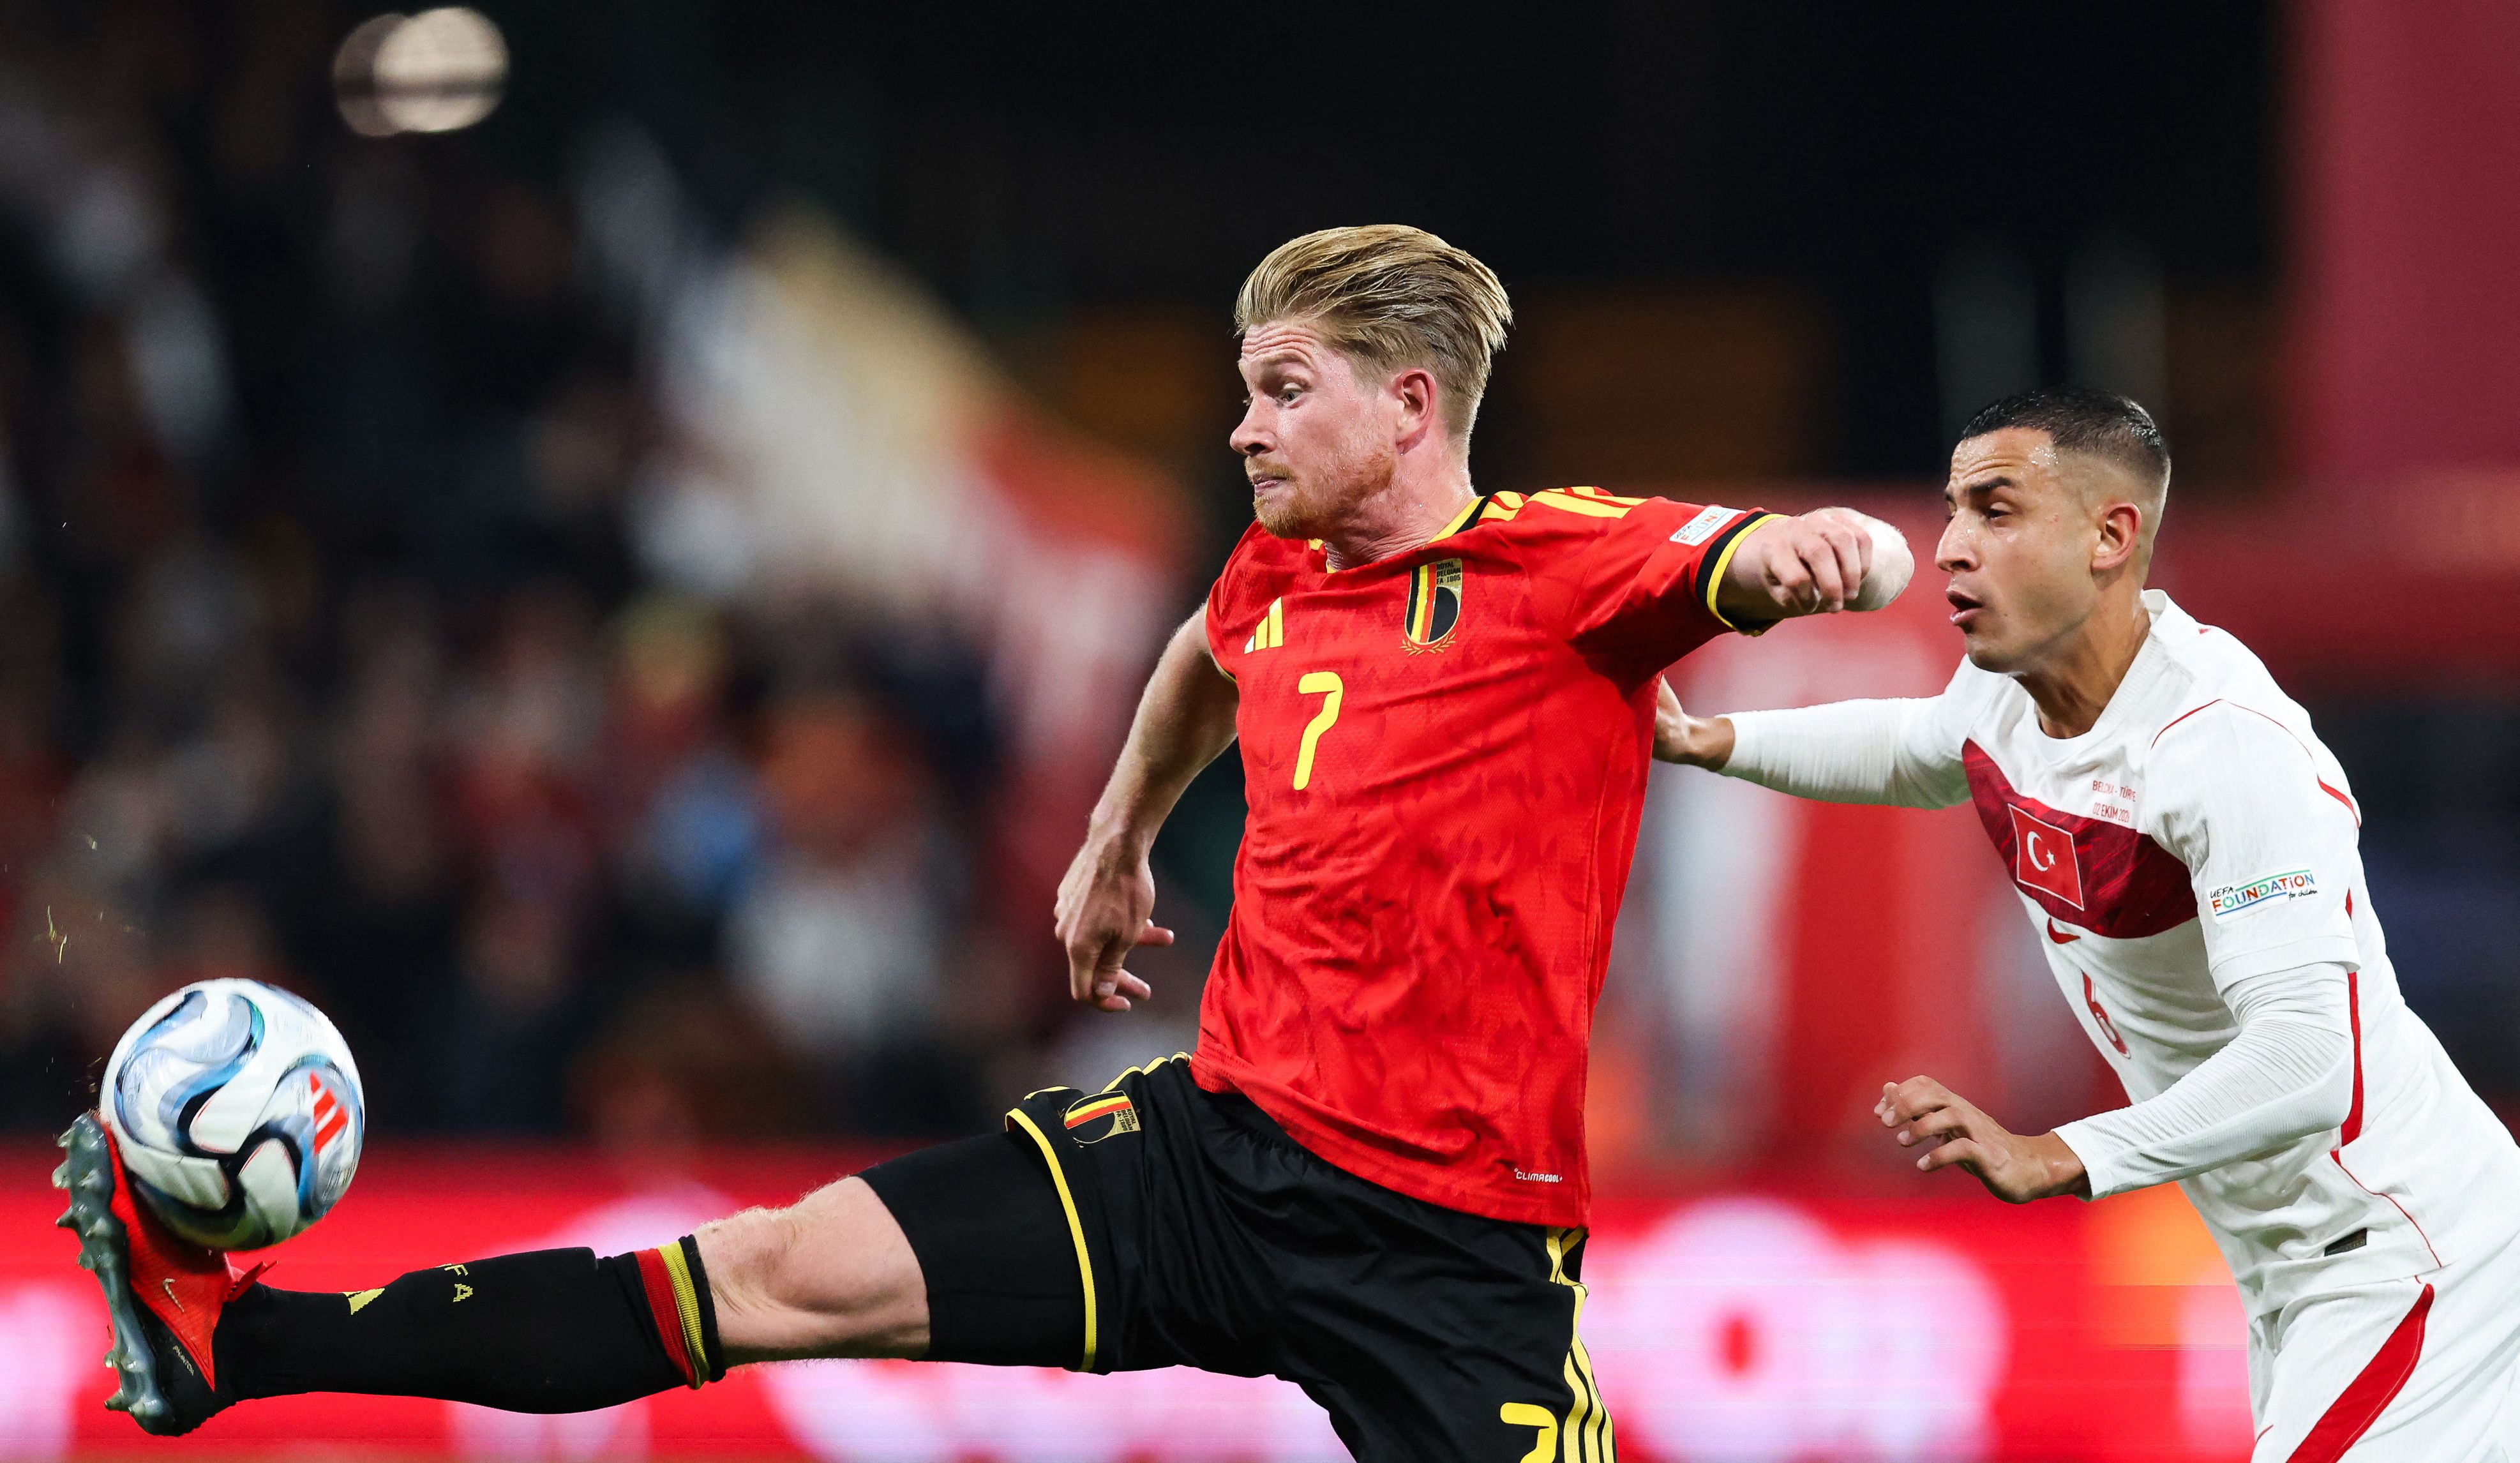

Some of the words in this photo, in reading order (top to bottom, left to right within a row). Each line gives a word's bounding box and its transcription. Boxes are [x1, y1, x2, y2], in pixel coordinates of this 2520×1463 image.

[1293, 671, 1344, 790] 7
[2210, 886, 2235, 899] UEFA
[2212, 873, 2315, 912] FOUNDATION
[2298, 887, 2318, 898] children
[2081, 971, 2131, 1060] 6
[1121, 1109, 1134, 1131] BELGIAN
[1126, 1108, 1136, 1124] ROYAL
